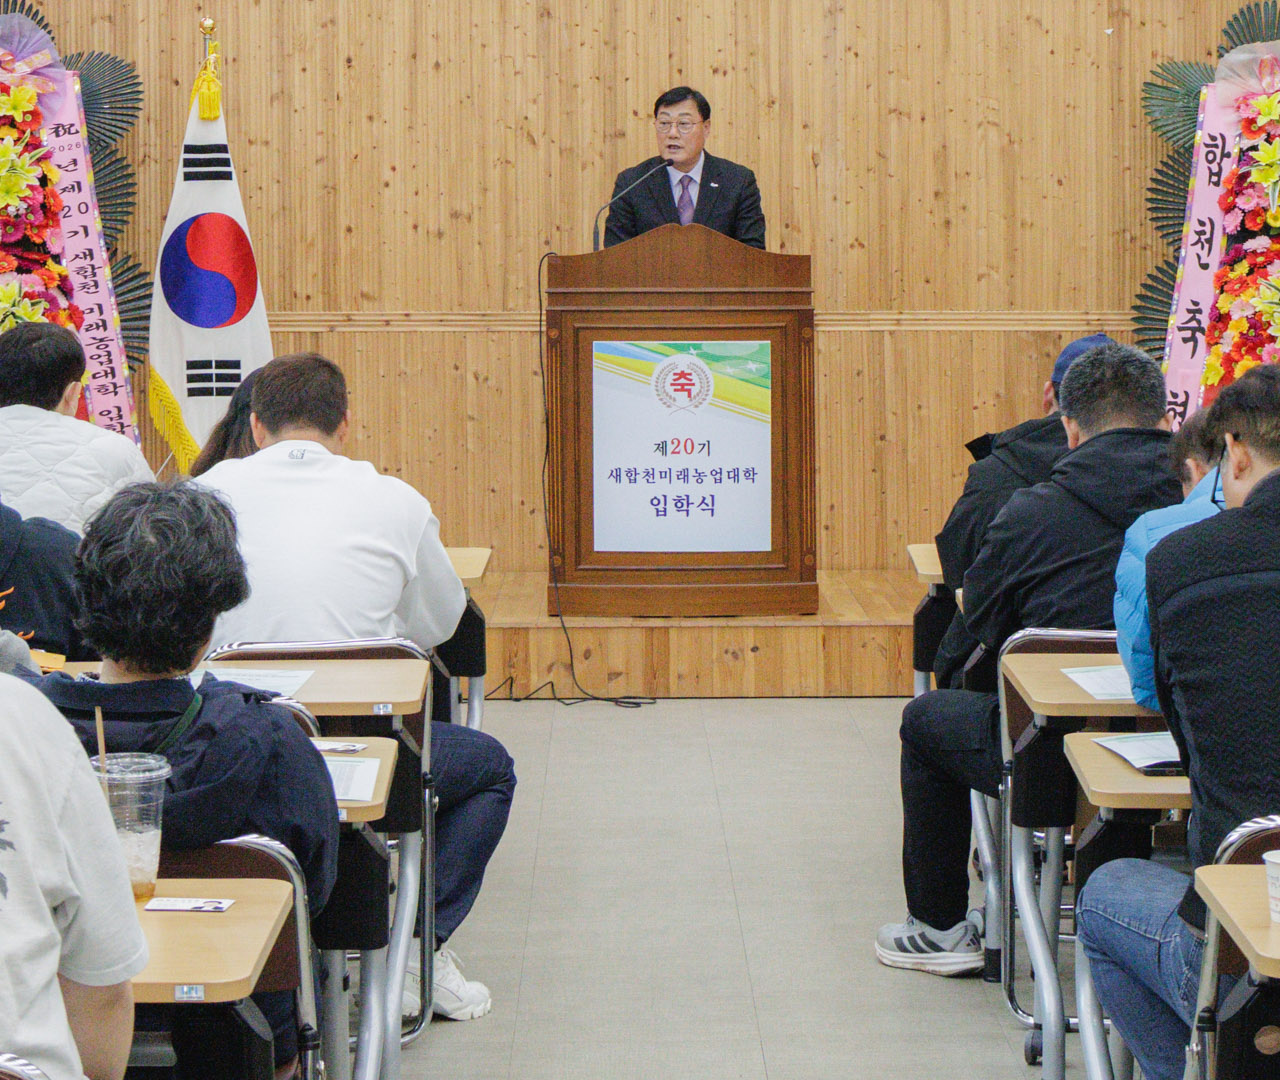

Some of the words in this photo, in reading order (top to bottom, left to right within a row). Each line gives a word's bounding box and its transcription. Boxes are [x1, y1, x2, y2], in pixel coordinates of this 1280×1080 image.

[48, 123, 80, 138] 祝
[82, 302, 124, 397] 미래농업대학
[669, 370, 696, 399] 축
[653, 437, 711, 457] 제20기
[607, 467, 759, 485] 새합천미래농업대학
[649, 494, 716, 518] 입학식
